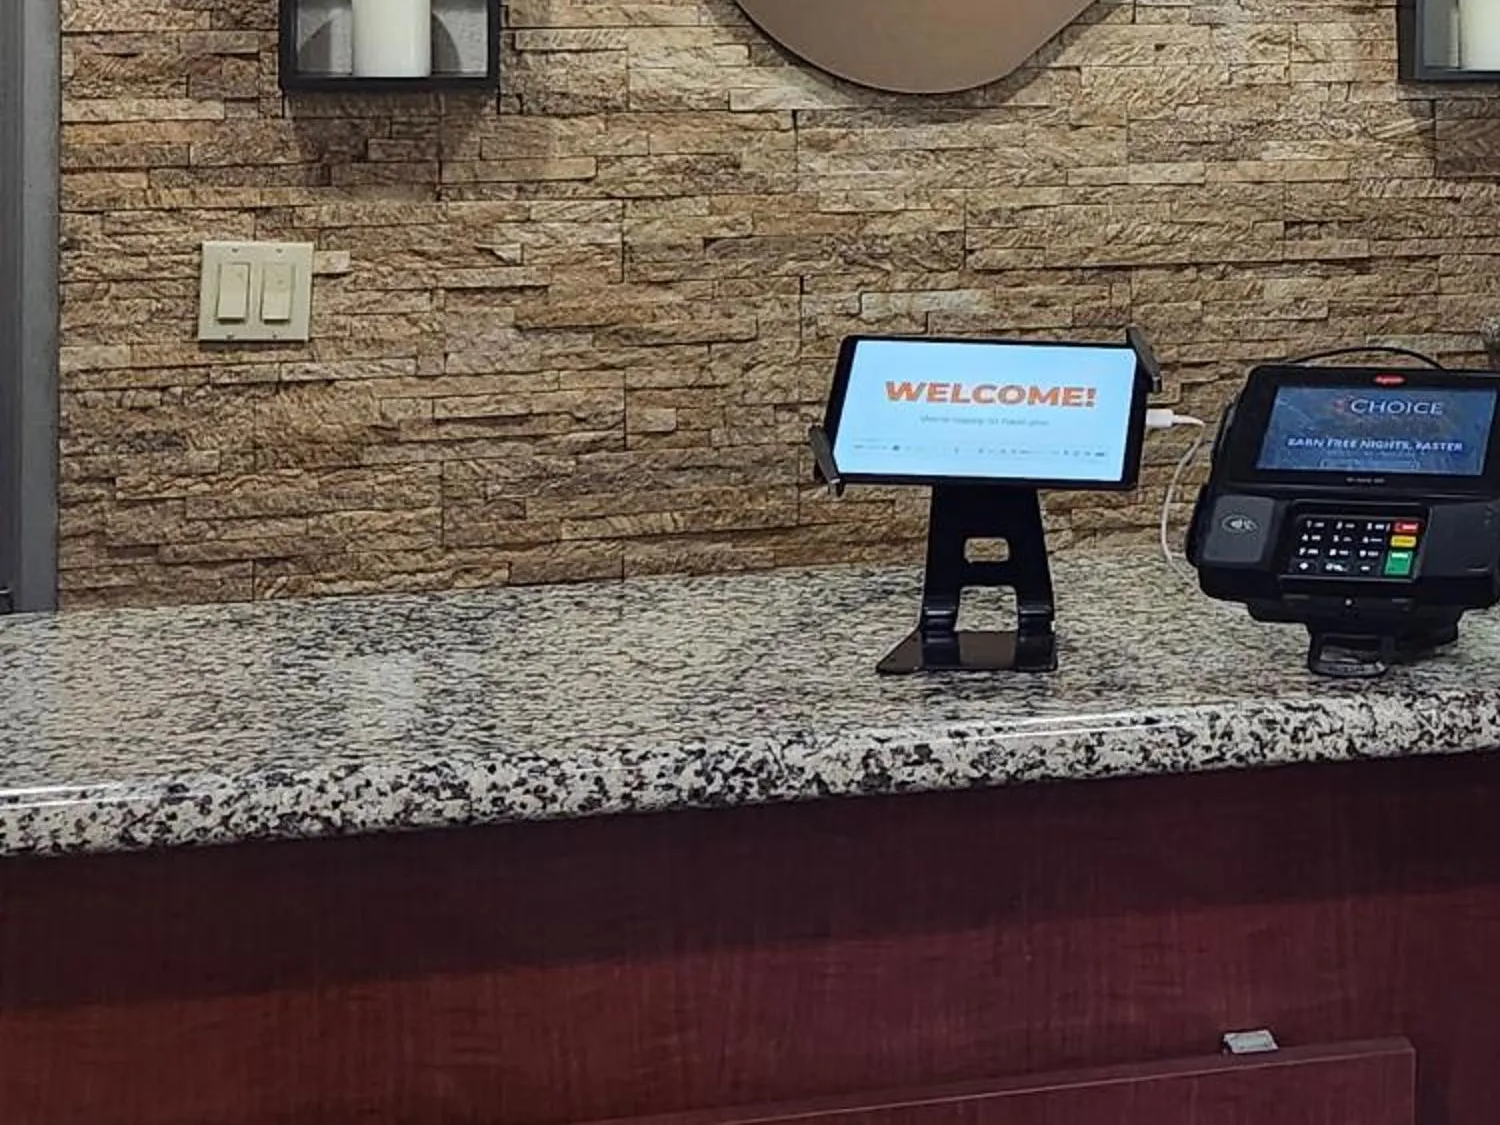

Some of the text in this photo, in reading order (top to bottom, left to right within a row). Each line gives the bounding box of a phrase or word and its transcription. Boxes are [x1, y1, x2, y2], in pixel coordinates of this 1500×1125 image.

[884, 380, 1098, 408] WELCOME!
[1350, 398, 1445, 416] CHOICE
[1287, 438, 1323, 449] EARN
[1326, 438, 1356, 449] FREE
[1415, 441, 1464, 452] FASTER
